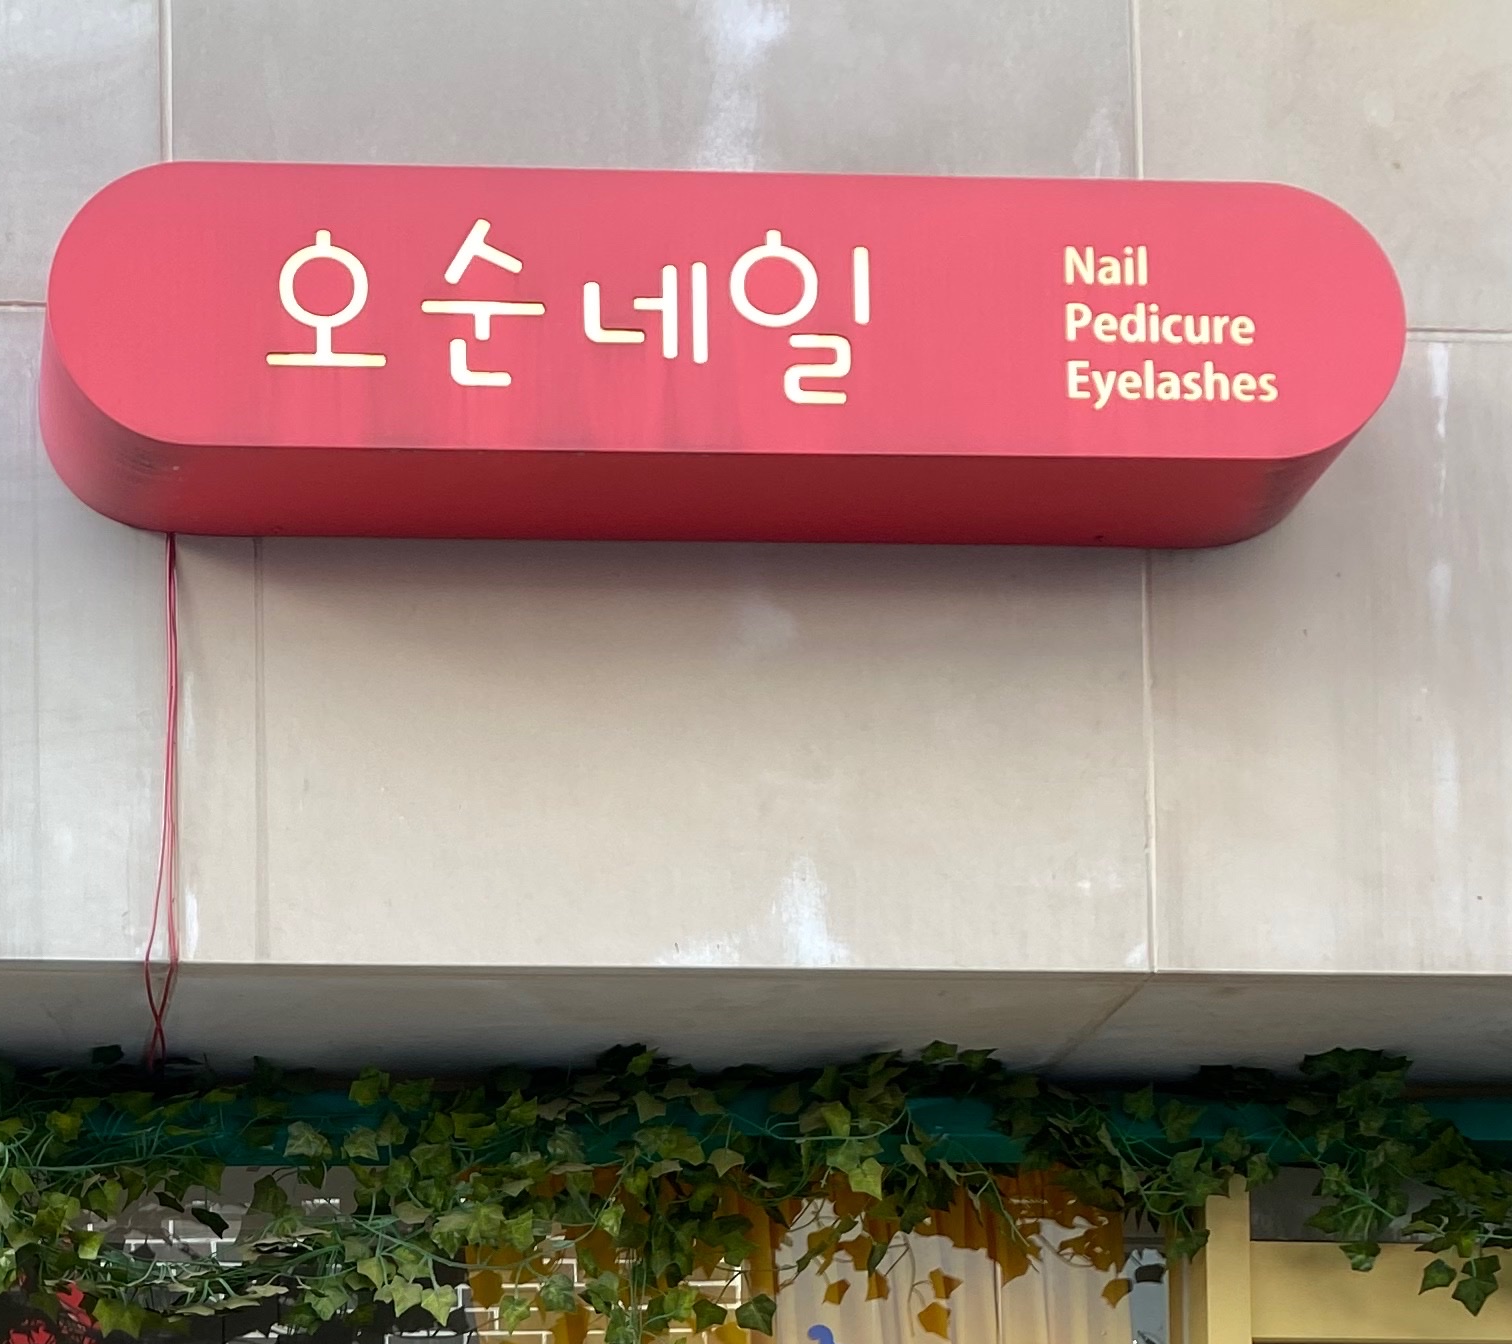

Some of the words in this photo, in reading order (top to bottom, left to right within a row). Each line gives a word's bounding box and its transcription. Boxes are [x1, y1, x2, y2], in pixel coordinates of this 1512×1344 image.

[1063, 245, 1149, 286] Nail
[265, 218, 871, 404] 오순네일
[1064, 302, 1257, 346] Pedicure
[1066, 359, 1280, 410] Eyelashes
